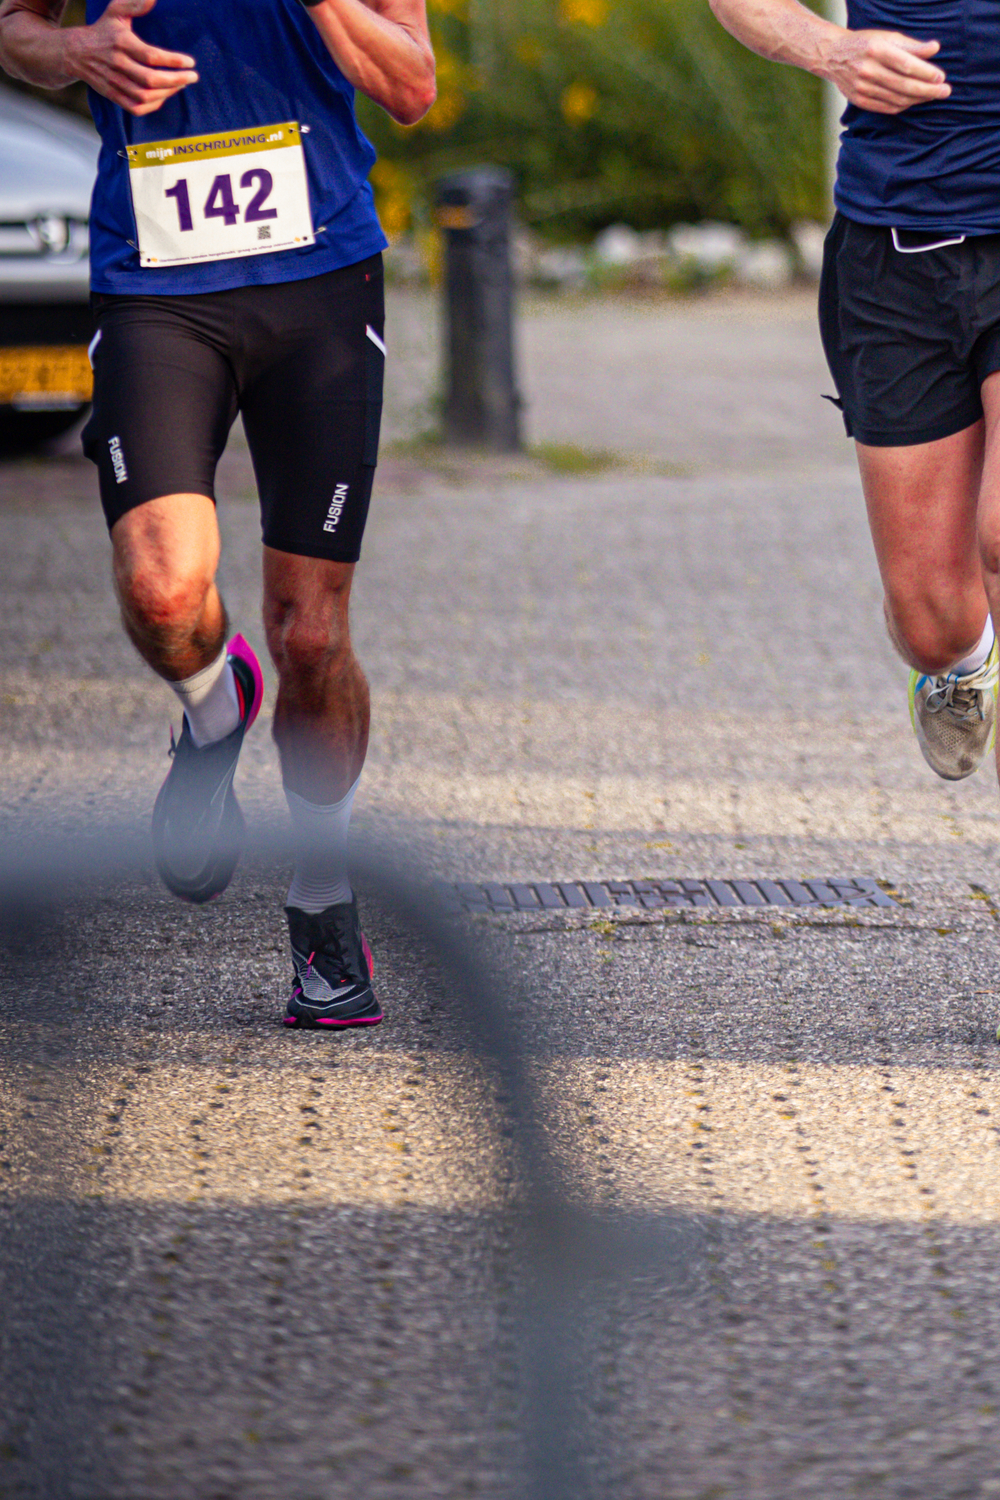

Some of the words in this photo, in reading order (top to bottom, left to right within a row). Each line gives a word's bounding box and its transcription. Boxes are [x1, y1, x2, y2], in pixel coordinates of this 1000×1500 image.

[164, 168, 278, 232] 142
[108, 436, 129, 484] FUSION
[323, 483, 349, 533] FUSION
